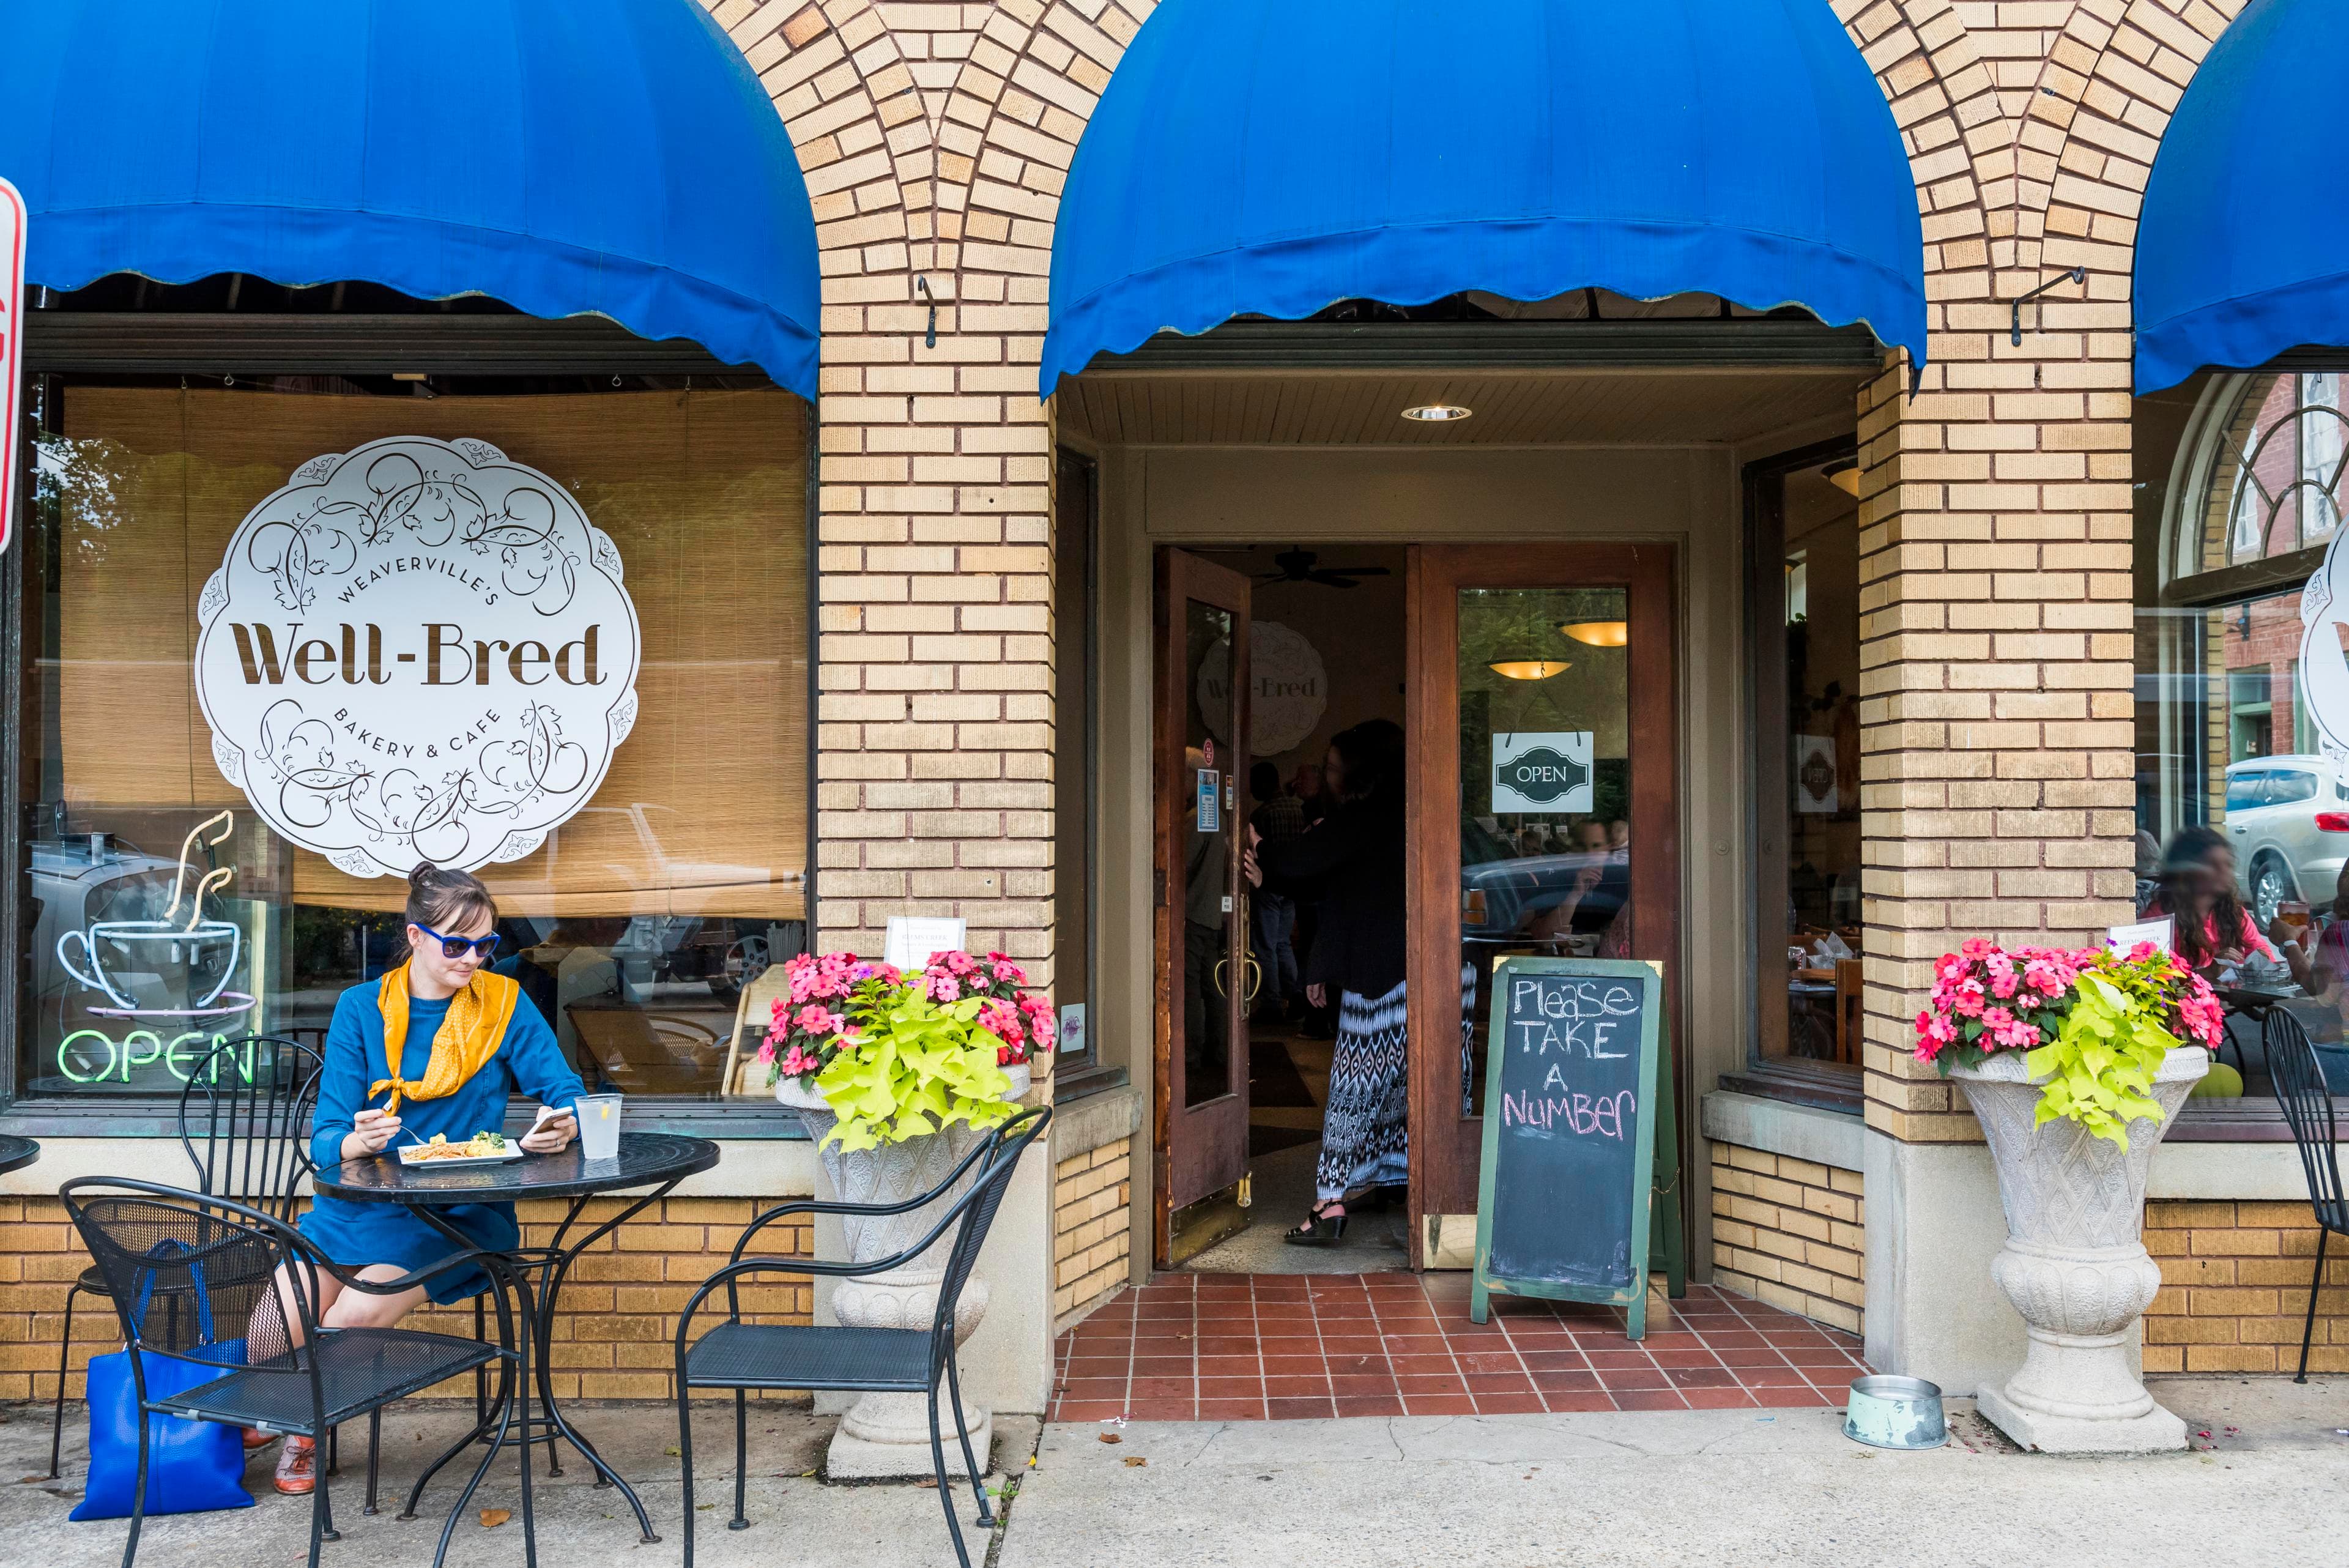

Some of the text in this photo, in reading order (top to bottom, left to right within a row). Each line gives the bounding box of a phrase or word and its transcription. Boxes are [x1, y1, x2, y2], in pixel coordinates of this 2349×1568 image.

[338, 557, 499, 606] WEAVERVILLE'S
[229, 623, 607, 686] Well-Bred
[335, 708, 501, 759] BAKERY & CAFE
[1516, 766, 1567, 782] OPEN
[1513, 980, 1640, 1022] Please
[58, 1029, 254, 1084] OPEN
[1513, 1020, 1630, 1060] TAKE
[1543, 1063, 1568, 1091] A
